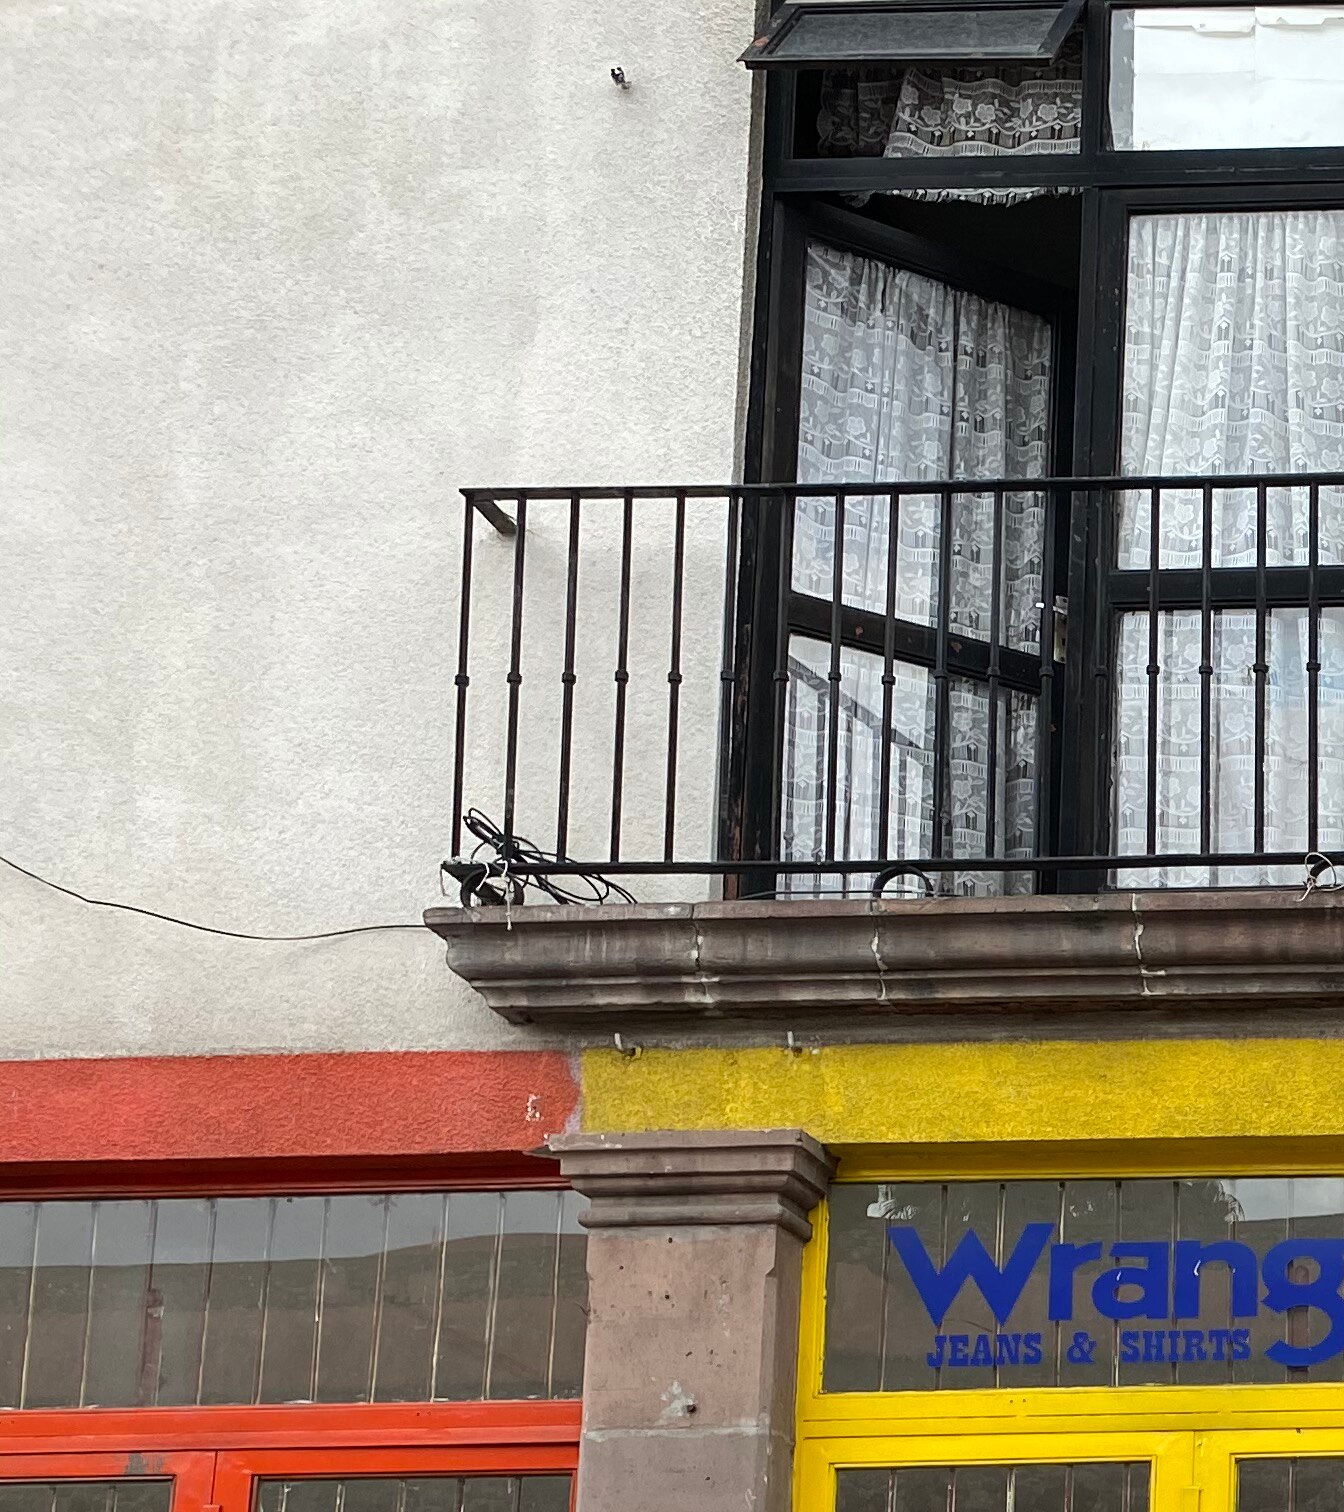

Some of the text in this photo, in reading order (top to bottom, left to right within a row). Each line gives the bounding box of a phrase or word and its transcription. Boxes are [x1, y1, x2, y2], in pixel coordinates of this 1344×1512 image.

[926, 1328, 1251, 1368] JEANS & SHIRTS
